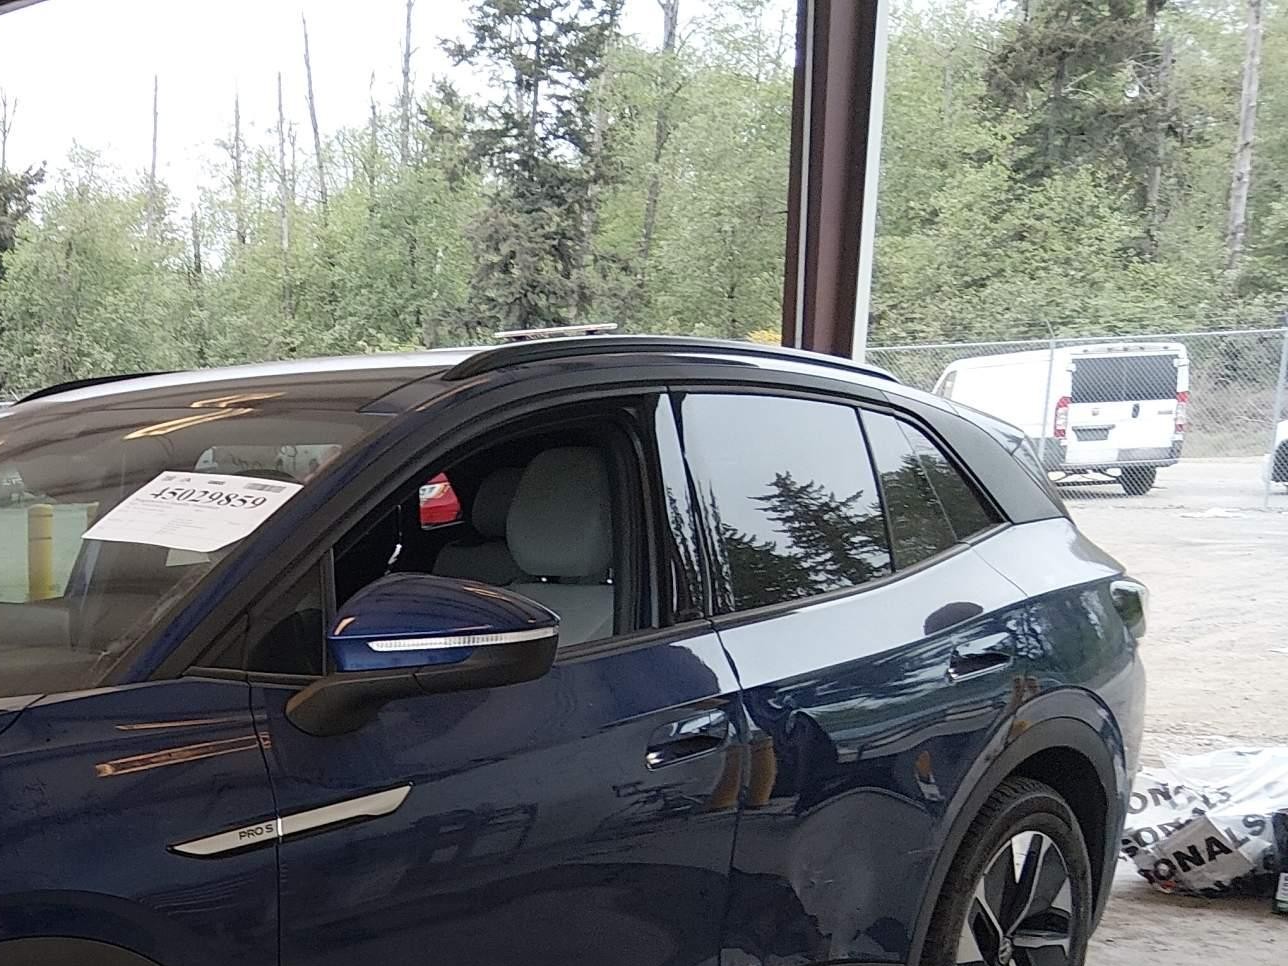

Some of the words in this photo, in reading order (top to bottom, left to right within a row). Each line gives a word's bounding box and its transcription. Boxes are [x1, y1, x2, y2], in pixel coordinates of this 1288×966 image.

[150, 486, 267, 509] 45029859
[238, 826, 263, 841] PRO
[263, 823, 274, 835] S
